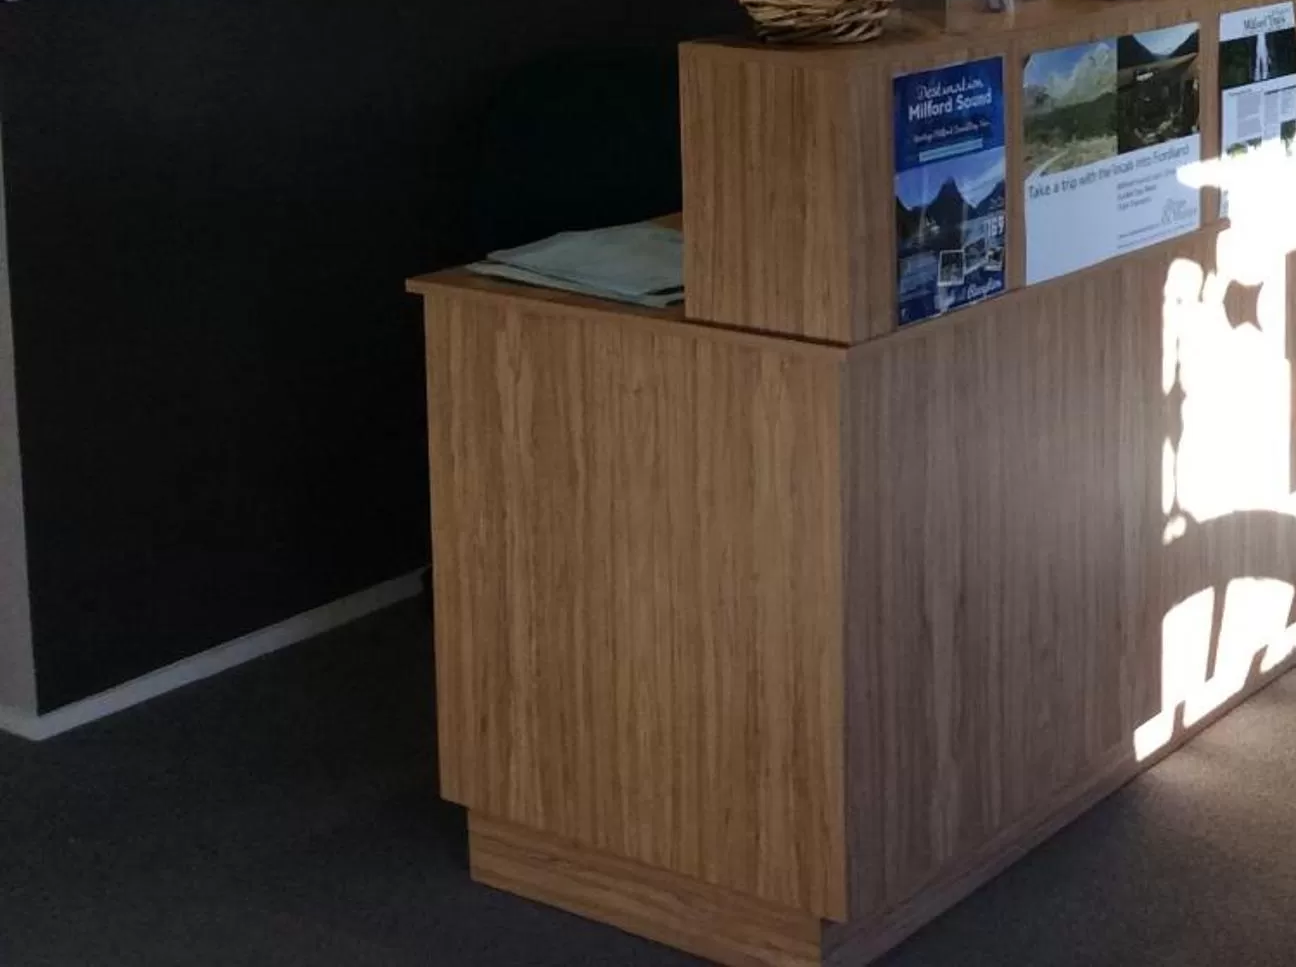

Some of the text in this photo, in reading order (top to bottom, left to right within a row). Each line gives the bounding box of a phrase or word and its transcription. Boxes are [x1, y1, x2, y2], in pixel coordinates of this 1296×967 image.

[908, 87, 993, 121] Milford Sound
[1029, 184, 1051, 199] Take
[1062, 178, 1077, 194] trip
